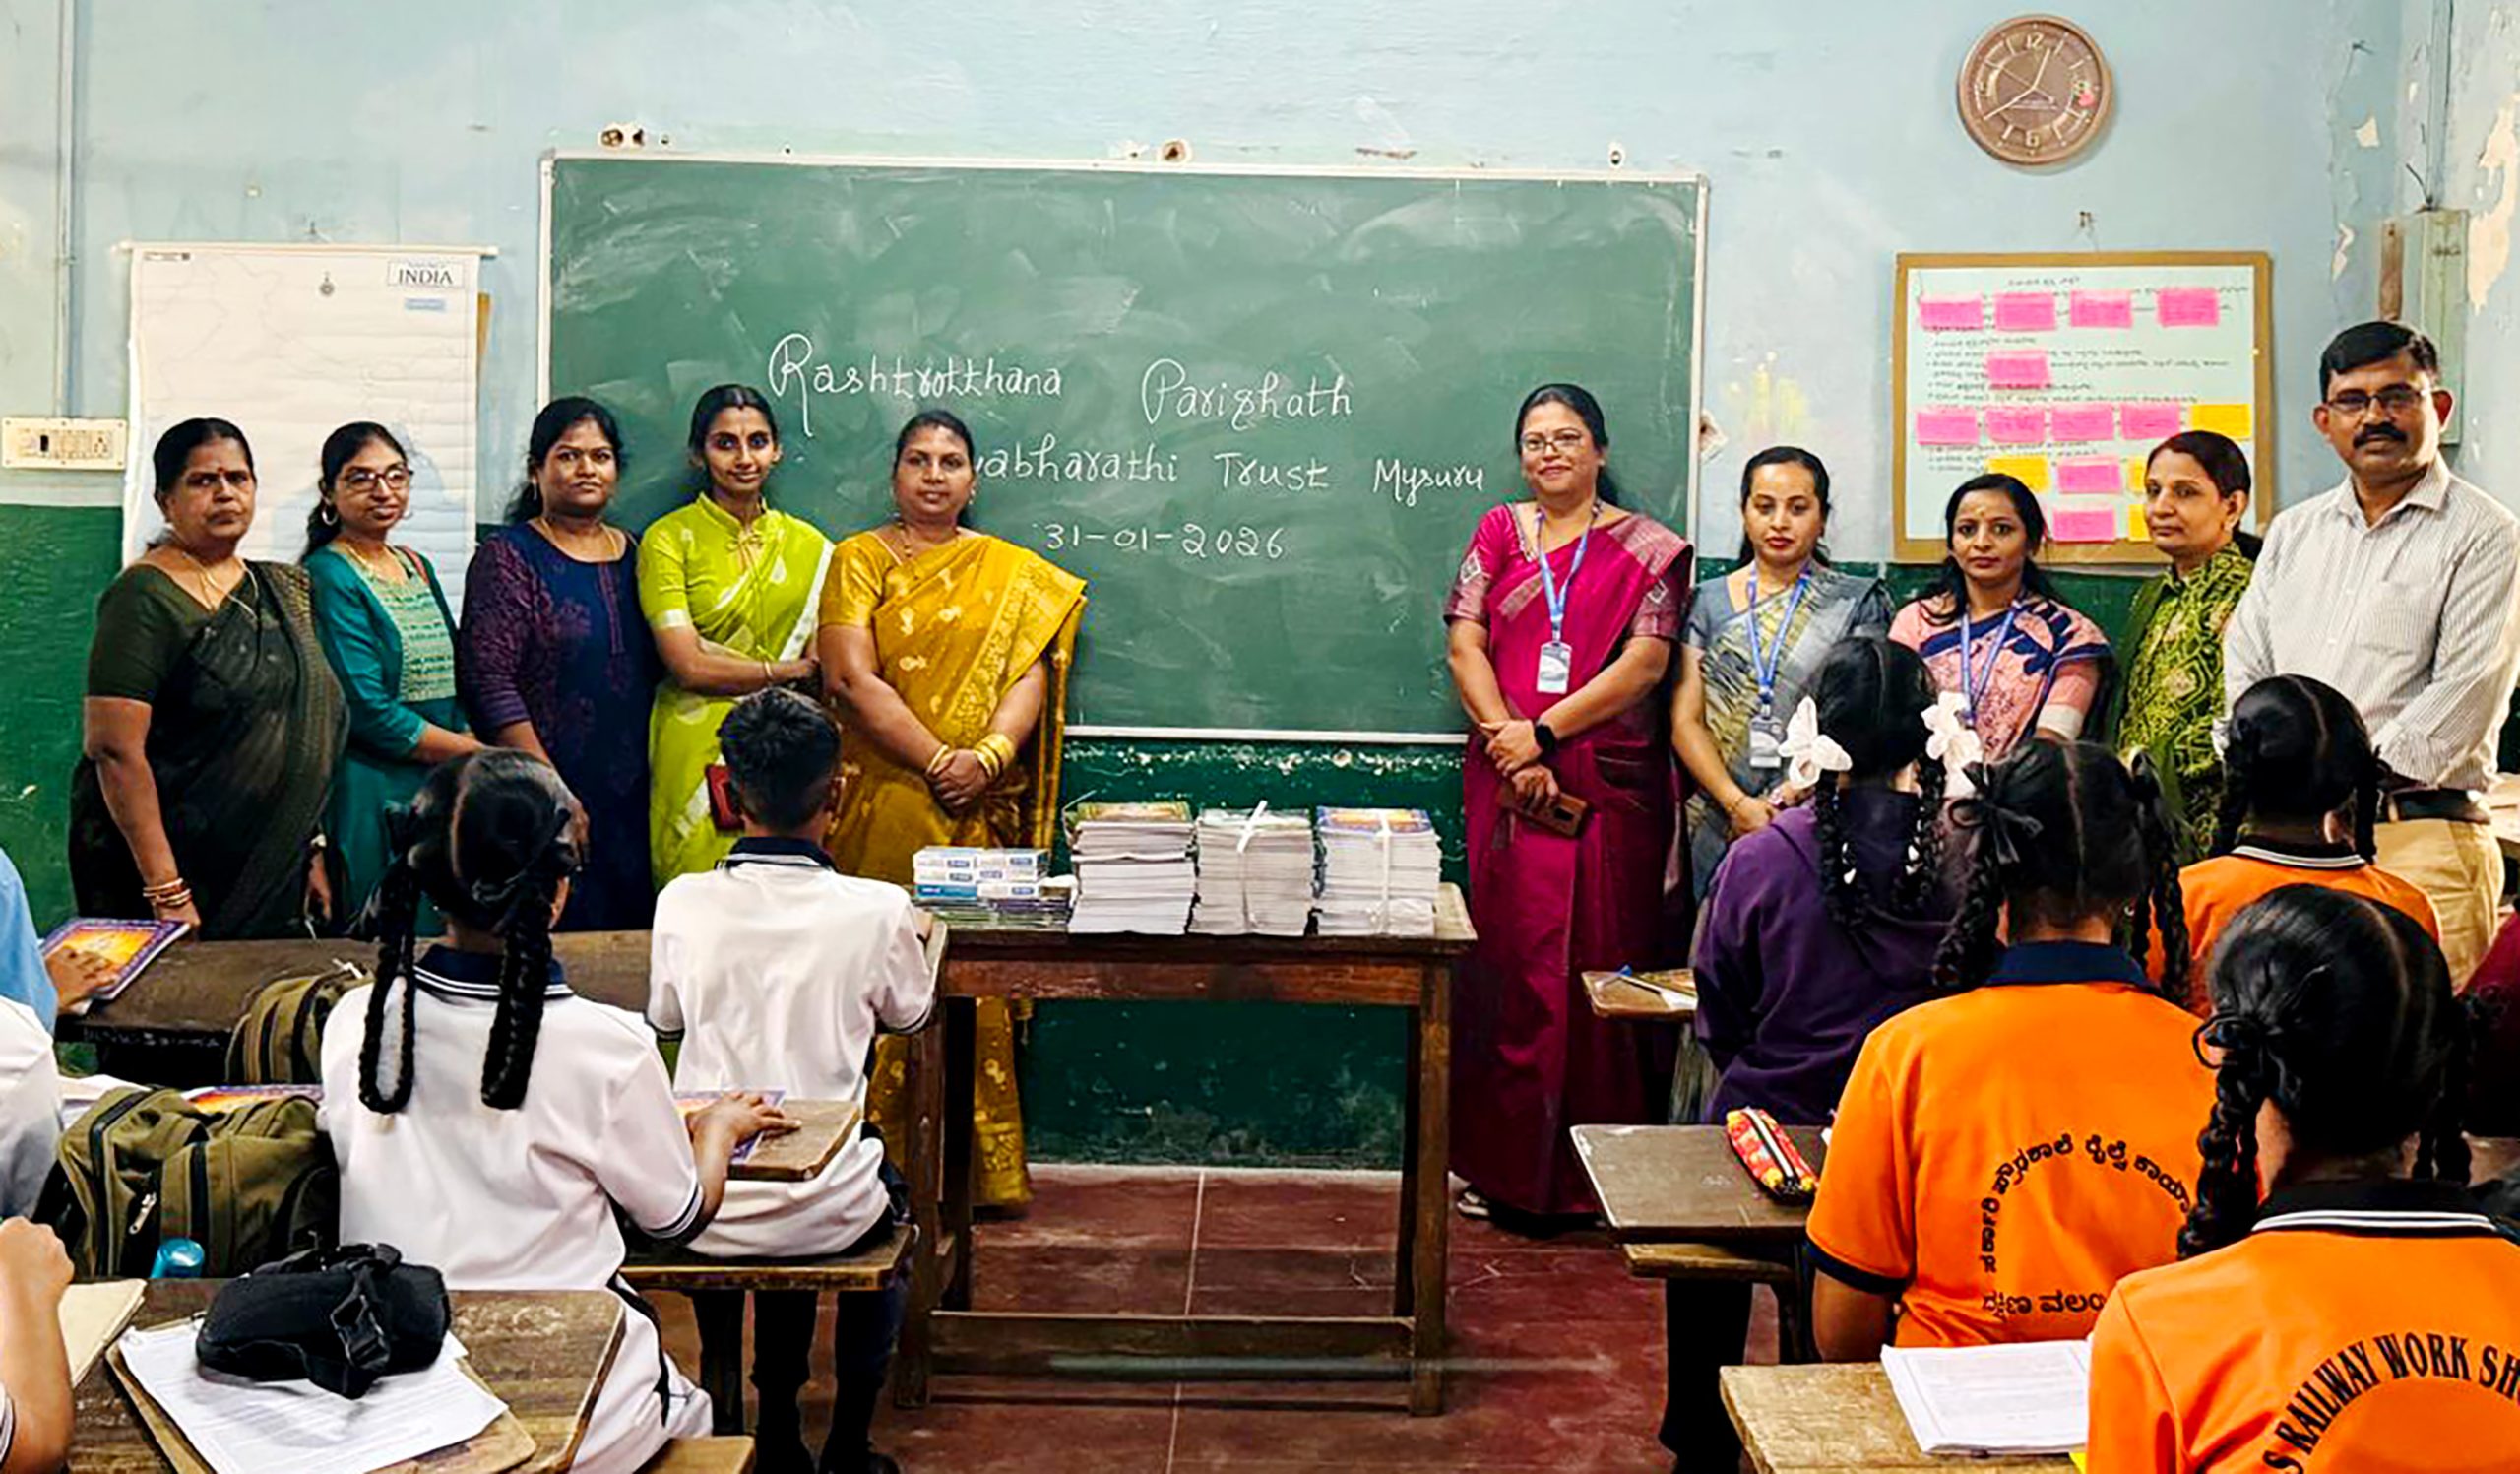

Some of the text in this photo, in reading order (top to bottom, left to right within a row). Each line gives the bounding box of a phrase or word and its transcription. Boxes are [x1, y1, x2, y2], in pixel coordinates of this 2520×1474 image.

[2025, 32, 2045, 49] 12
[399, 268, 453, 285] INDIA
[769, 333, 1062, 437] Rashtrotthana
[976, 433, 1483, 507] abharathi Trust Mysuru
[1044, 522, 1284, 559] 31-01-2026
[2274, 1340, 2381, 1455] RAILWAY
[2372, 1332, 2472, 1379] WORK
[2478, 1344, 2520, 1407] SH
